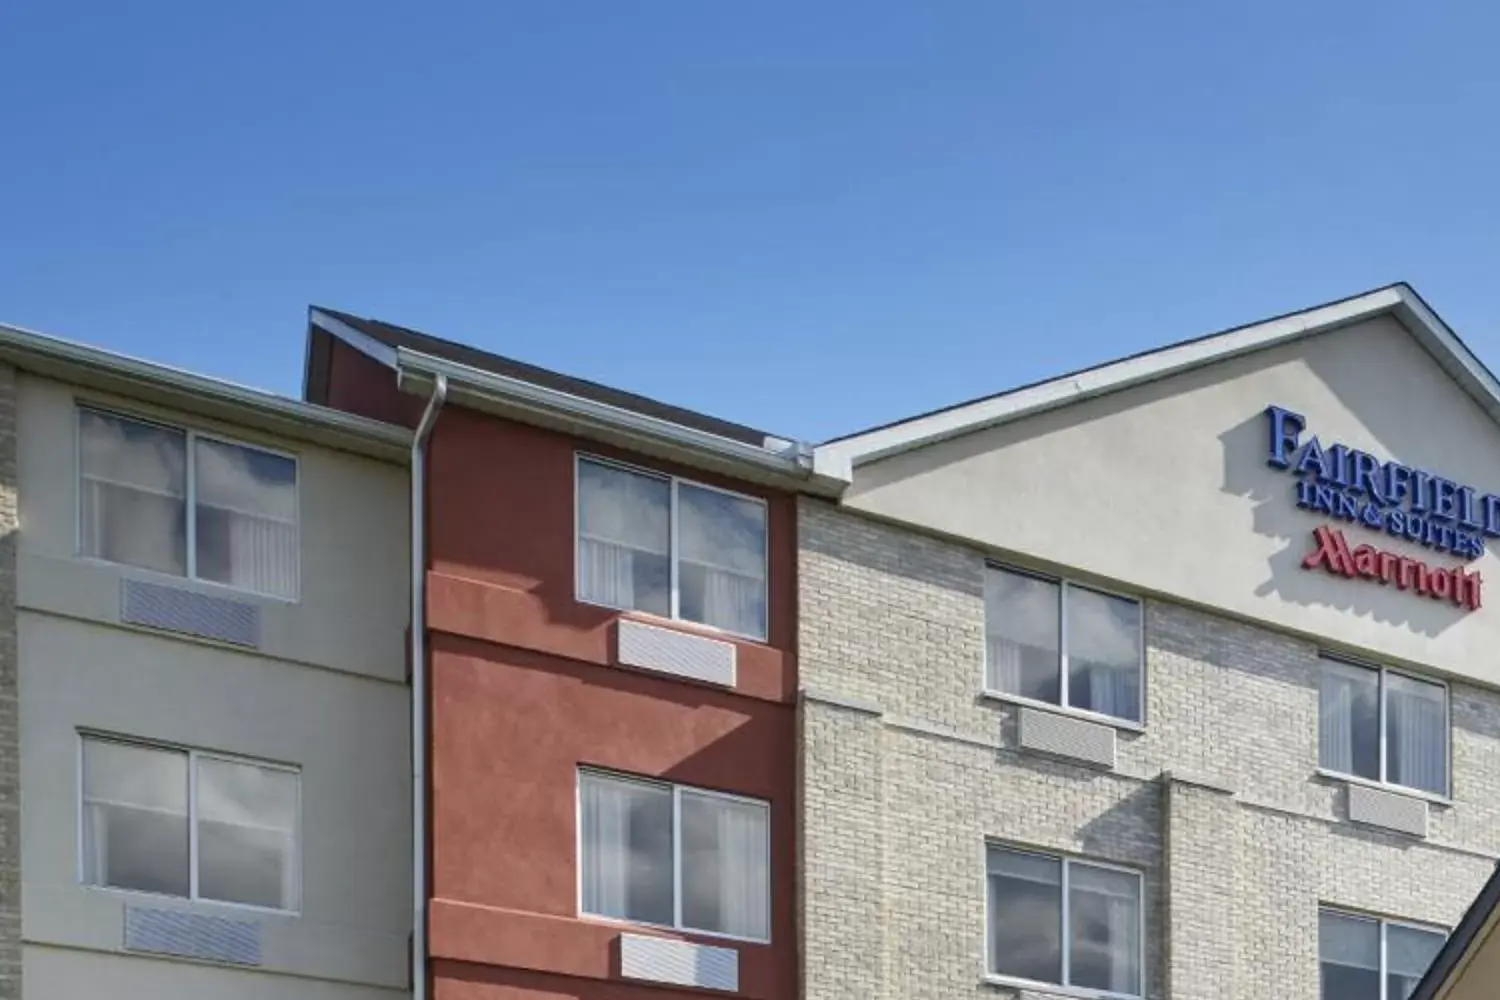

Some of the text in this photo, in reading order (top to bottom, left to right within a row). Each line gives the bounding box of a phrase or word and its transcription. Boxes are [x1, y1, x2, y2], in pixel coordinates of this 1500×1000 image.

[1295, 480, 1486, 561] INN & SUITES
[1301, 524, 1483, 611] Marriott
